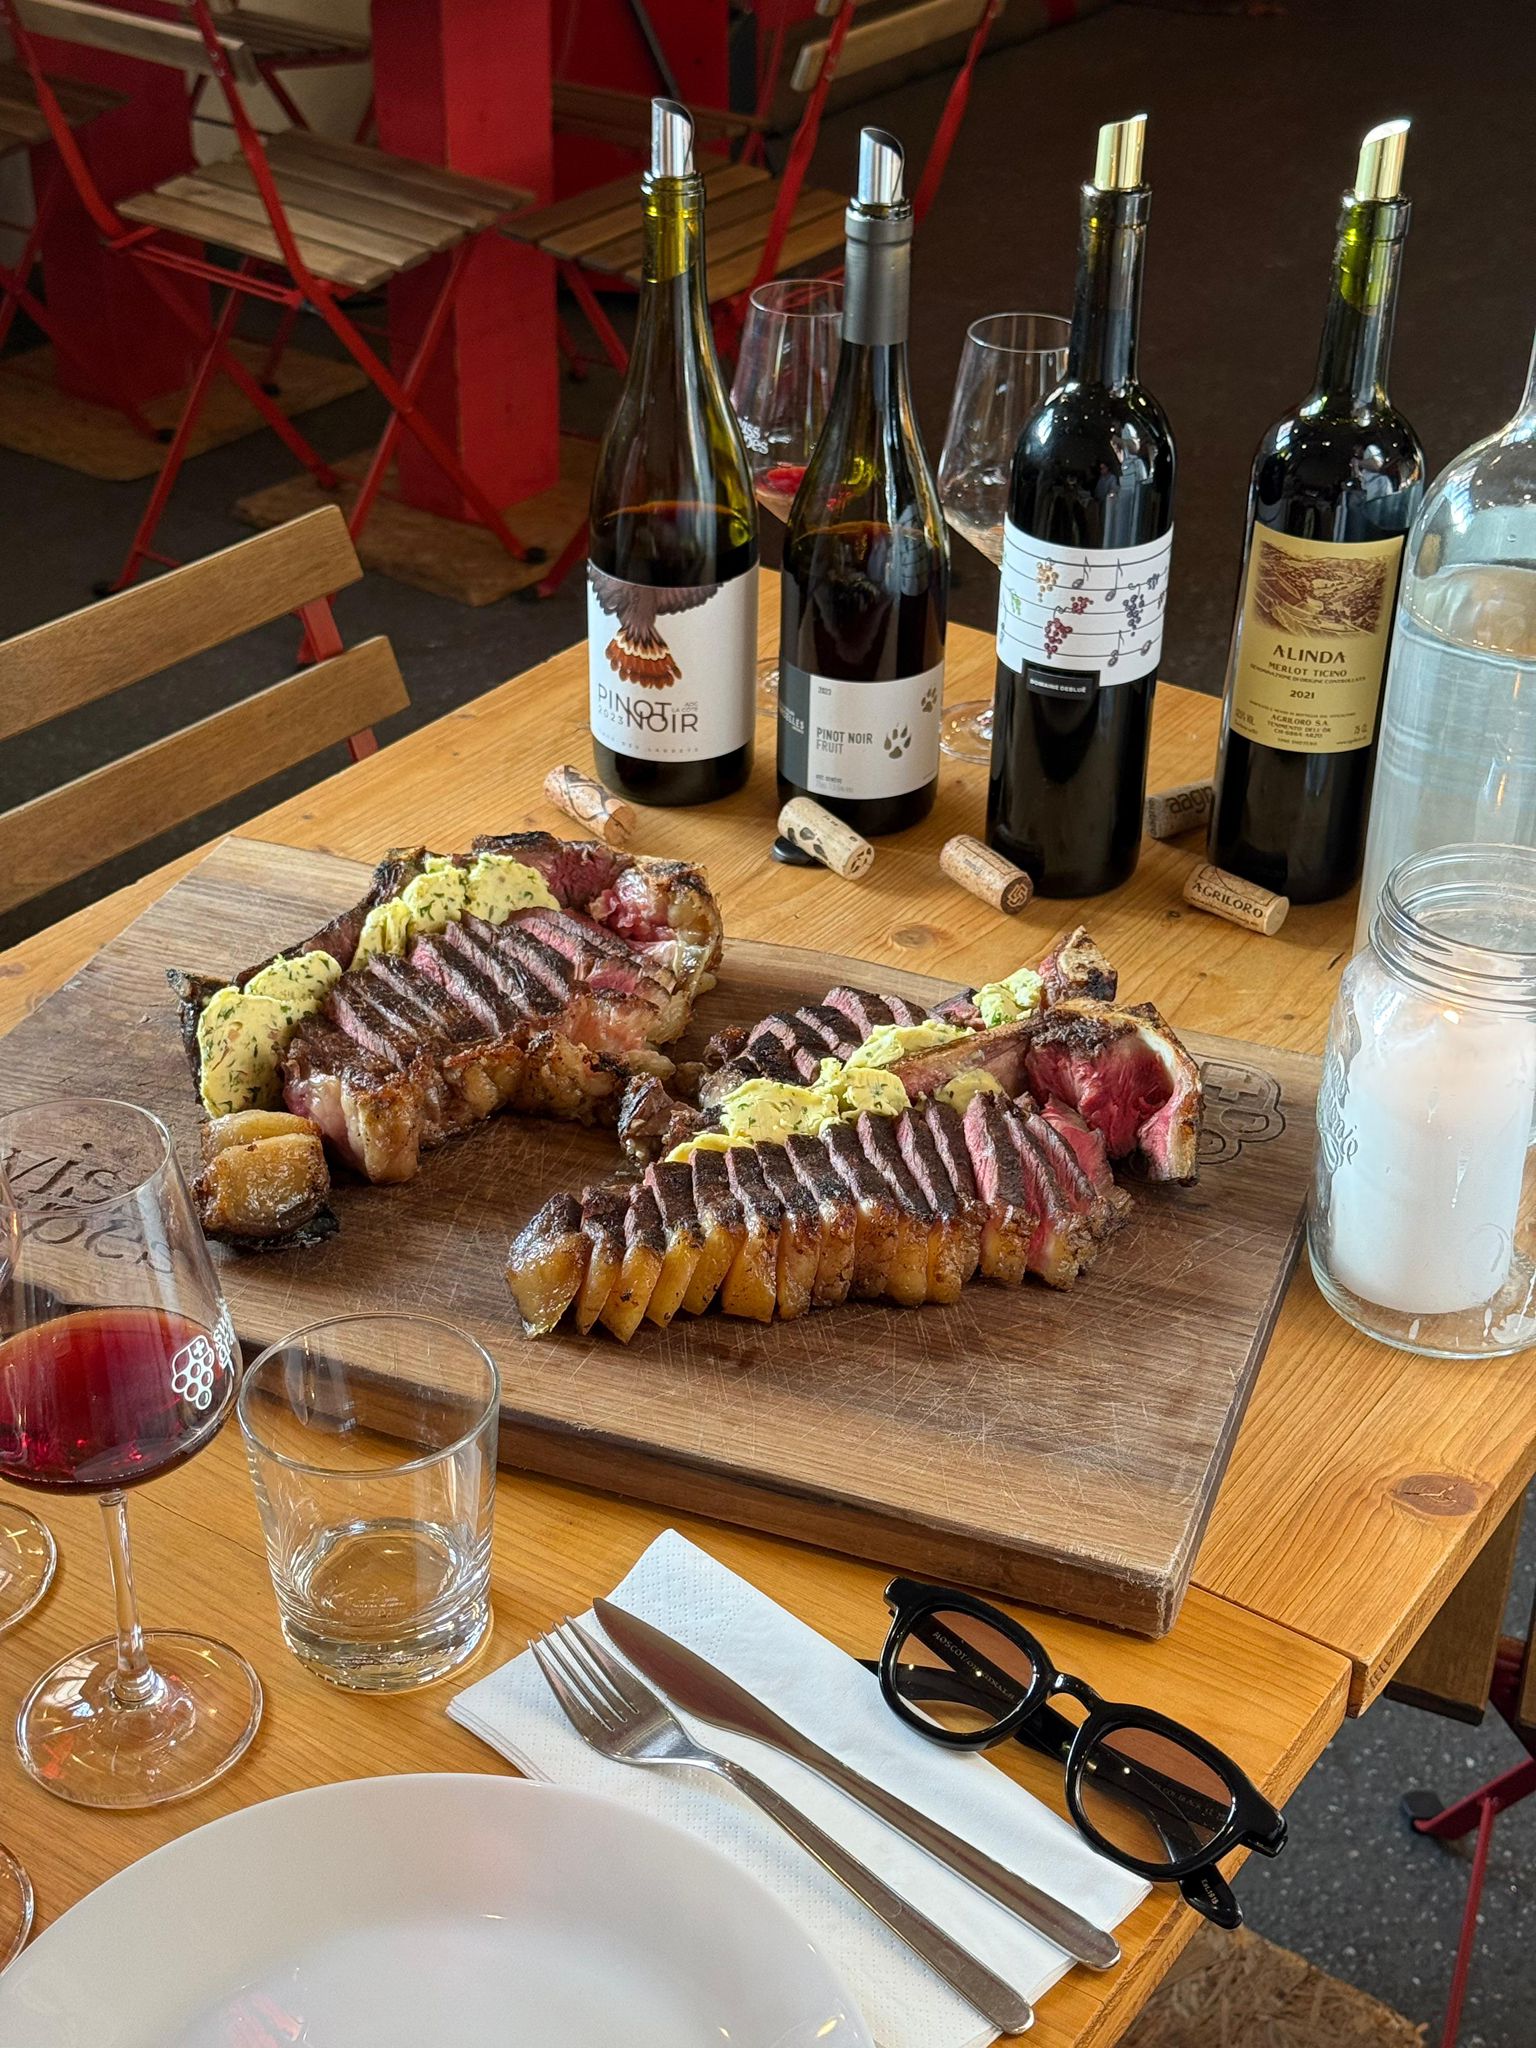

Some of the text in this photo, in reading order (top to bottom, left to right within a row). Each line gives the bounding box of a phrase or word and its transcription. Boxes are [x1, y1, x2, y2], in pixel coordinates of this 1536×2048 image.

[1272, 644, 1346, 664] ALINDA
[1268, 661, 1347, 678] MERLOT TICINO
[598, 683, 672, 721] PINOT
[1289, 689, 1315, 699] 2021
[598, 704, 698, 733] 2023 NOIR
[1270, 714, 1312, 726] AGRILORO
[816, 727, 845, 743] PINOT
[848, 732, 873, 745] NOIR
[816, 739, 844, 754] FRUIT
[1192, 882, 1264, 918] AGRILORO
